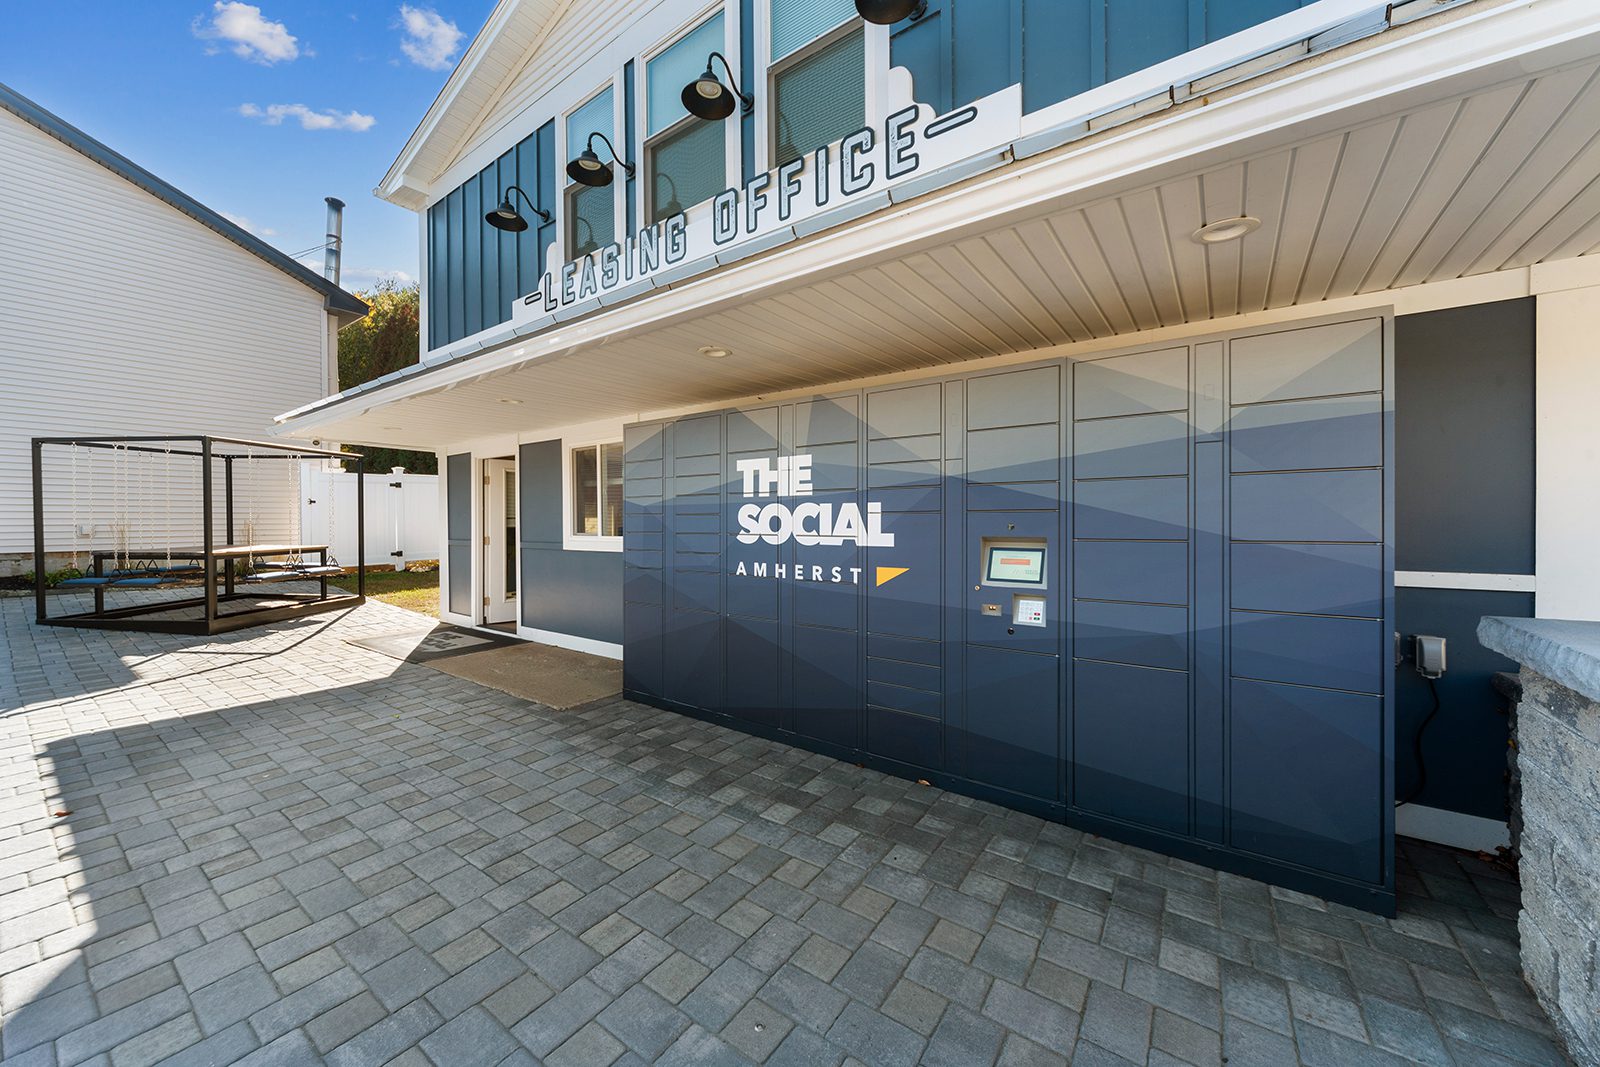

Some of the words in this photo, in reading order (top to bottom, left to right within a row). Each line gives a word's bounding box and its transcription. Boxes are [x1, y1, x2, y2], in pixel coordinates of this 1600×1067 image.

[544, 211, 687, 312] LEASING
[713, 105, 919, 245] OFFICE
[736, 454, 813, 497] THE
[736, 502, 894, 547] SOCIAL
[736, 561, 862, 585] AMHERST
